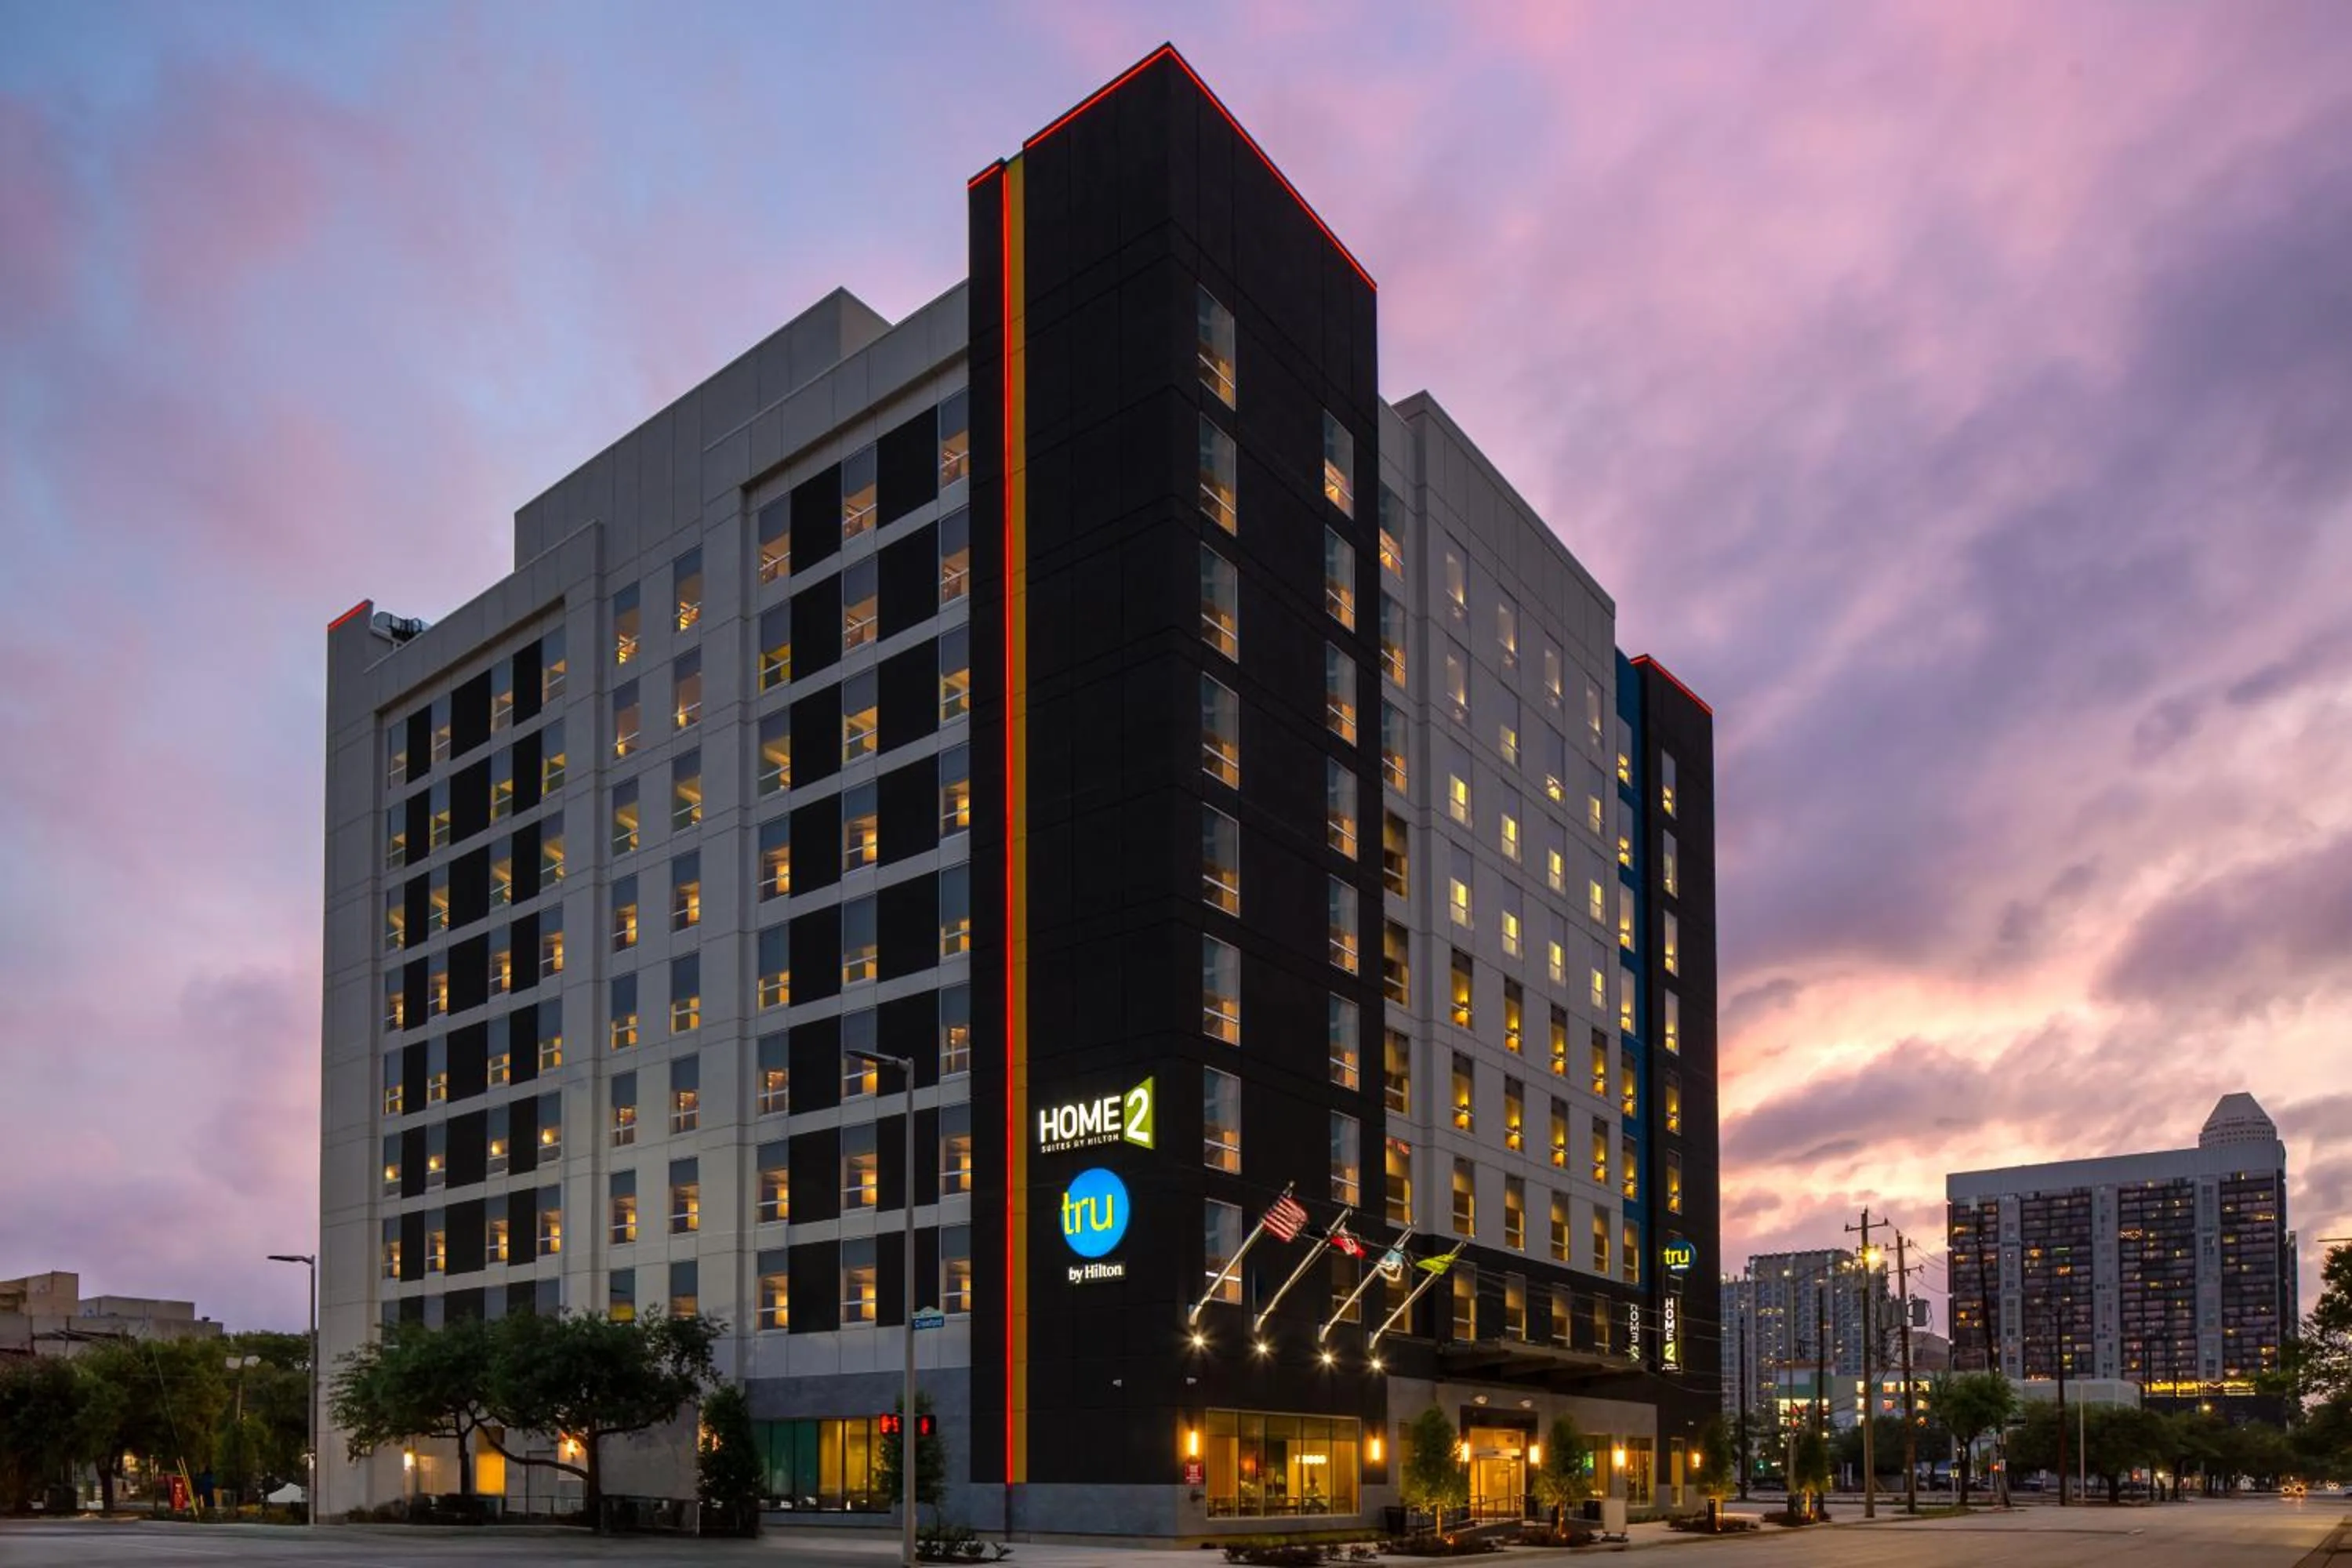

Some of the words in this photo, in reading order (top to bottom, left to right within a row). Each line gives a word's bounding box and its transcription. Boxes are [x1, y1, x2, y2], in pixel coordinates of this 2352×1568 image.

[1041, 1141, 1070, 1153] SUITES
[1073, 1139, 1085, 1149] BY
[1088, 1133, 1120, 1145] HILTON
[1062, 1192, 1112, 1235] tru
[1664, 1248, 1690, 1265] tru
[1069, 1267, 1083, 1283] by
[1084, 1263, 1122, 1279] Hilton
